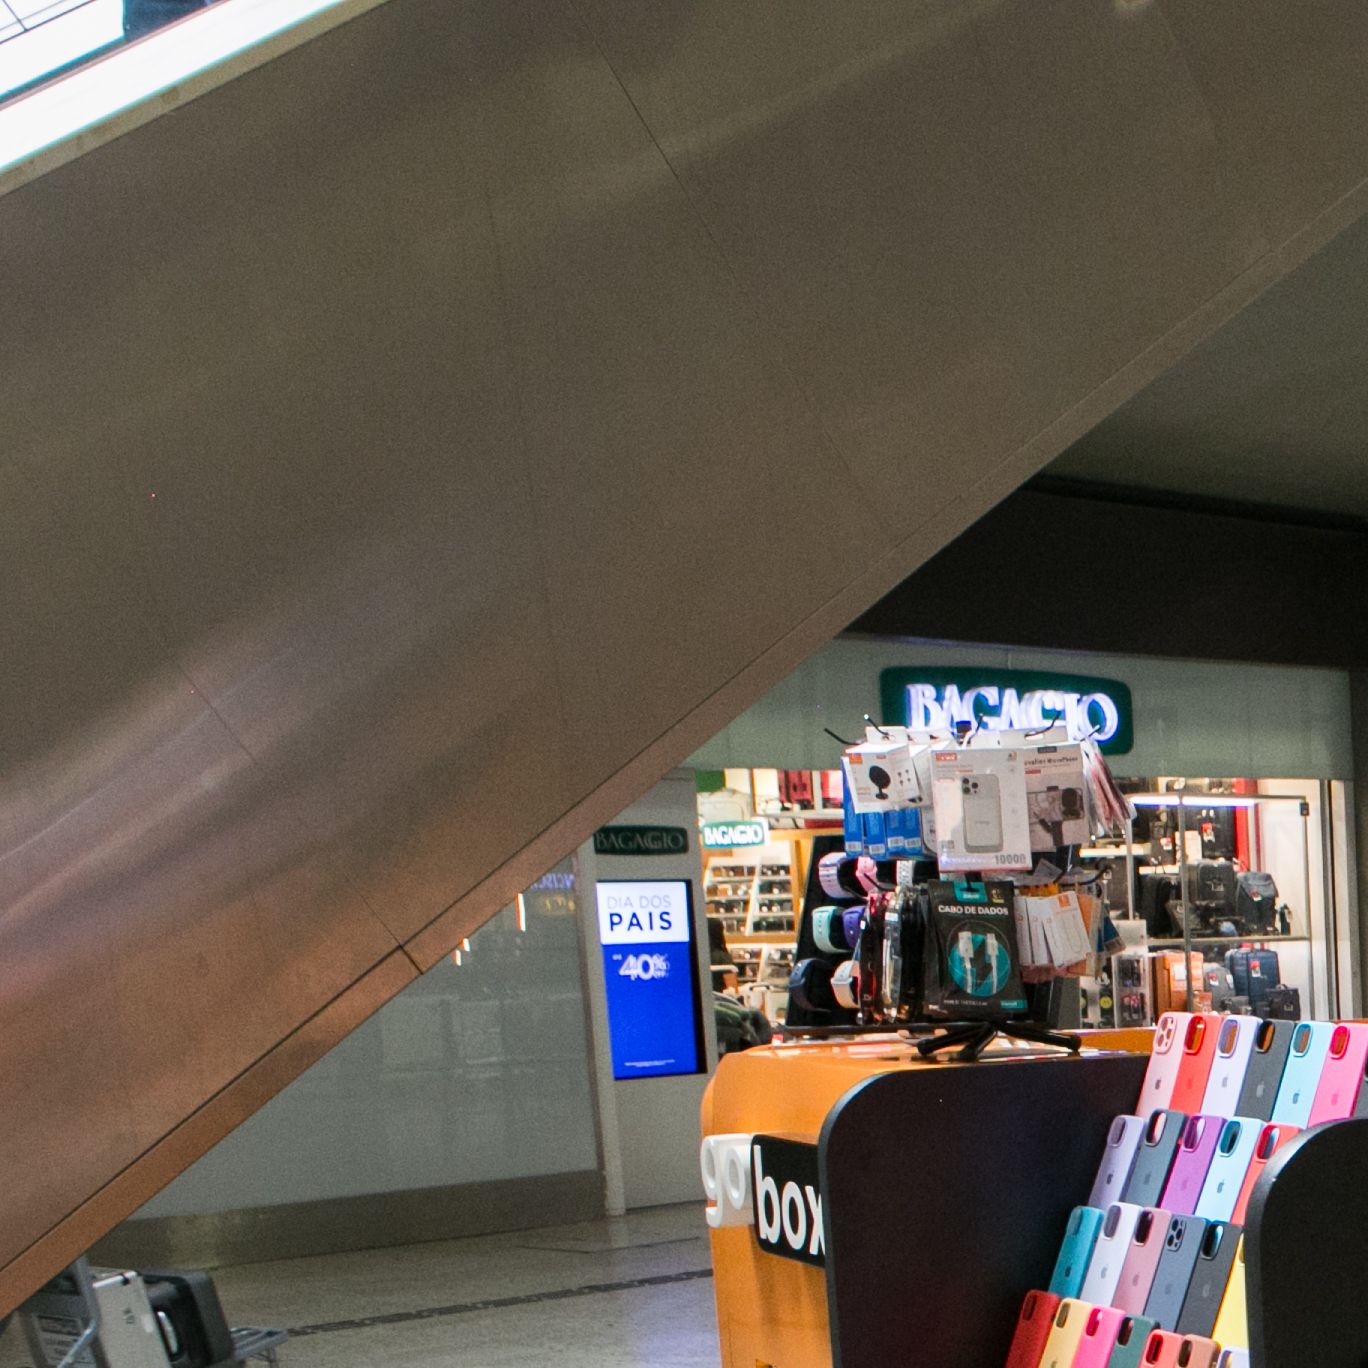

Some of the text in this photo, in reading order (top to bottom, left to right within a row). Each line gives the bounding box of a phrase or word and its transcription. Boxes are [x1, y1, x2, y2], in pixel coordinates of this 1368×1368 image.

[607, 894, 671, 910] DIA DOS
[938, 904, 1008, 916] CABO DE DADOS
[609, 911, 673, 931] PAIS
[701, 1134, 826, 1255] go box
